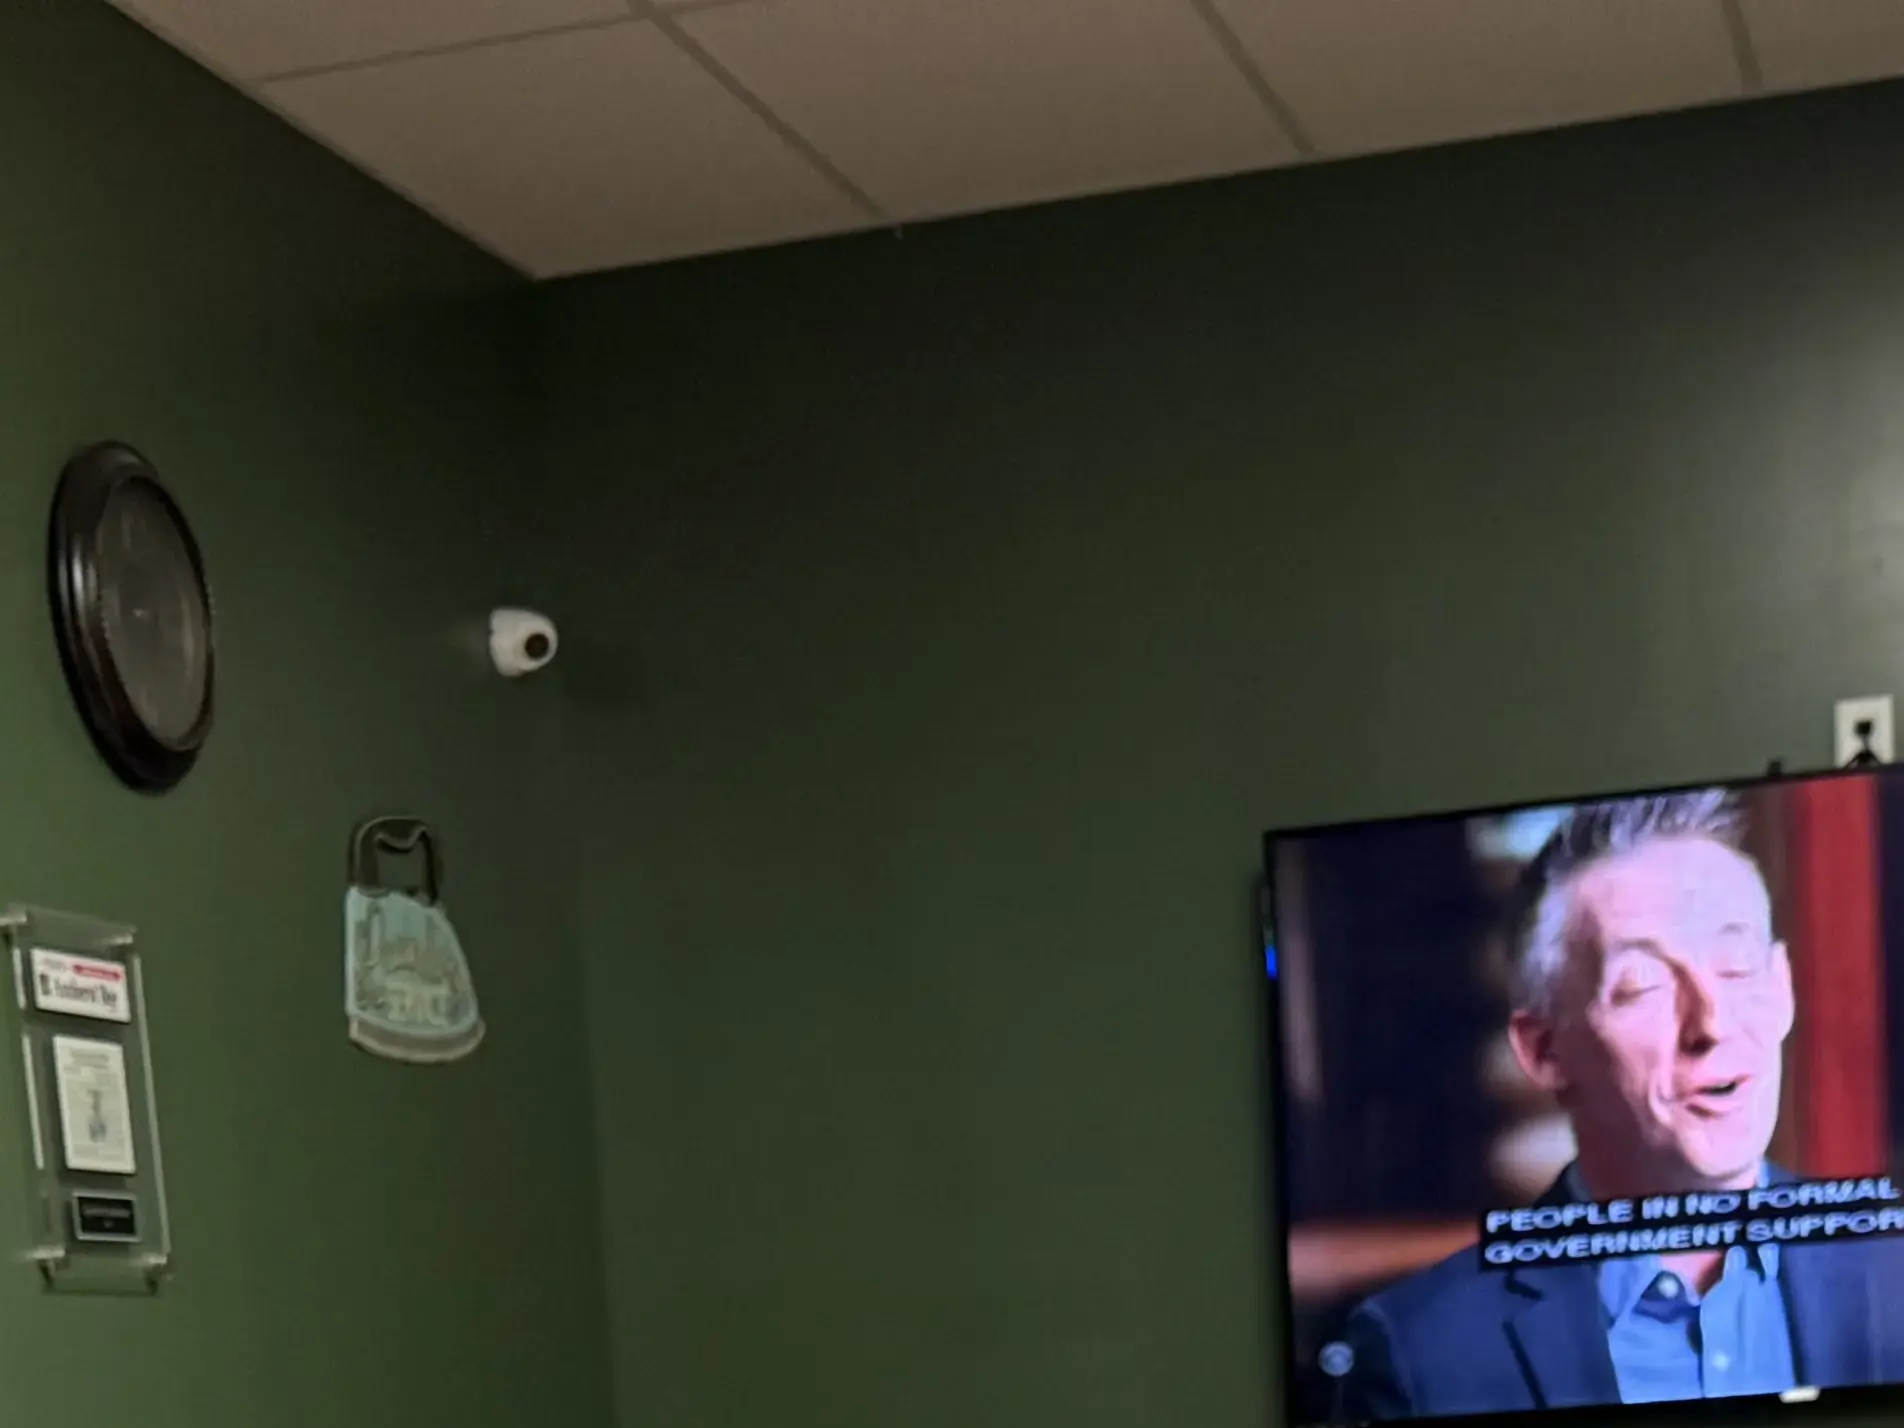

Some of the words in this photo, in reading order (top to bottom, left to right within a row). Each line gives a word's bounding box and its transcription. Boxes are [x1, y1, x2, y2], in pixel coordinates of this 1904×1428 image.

[1485, 1199, 1632, 1234] PEOPLE
[1642, 1196, 1679, 1220] IN
[1686, 1190, 1743, 1215] NO
[1748, 1174, 1901, 1211] FORMAL
[1484, 1222, 1742, 1265] GOVERNMENT
